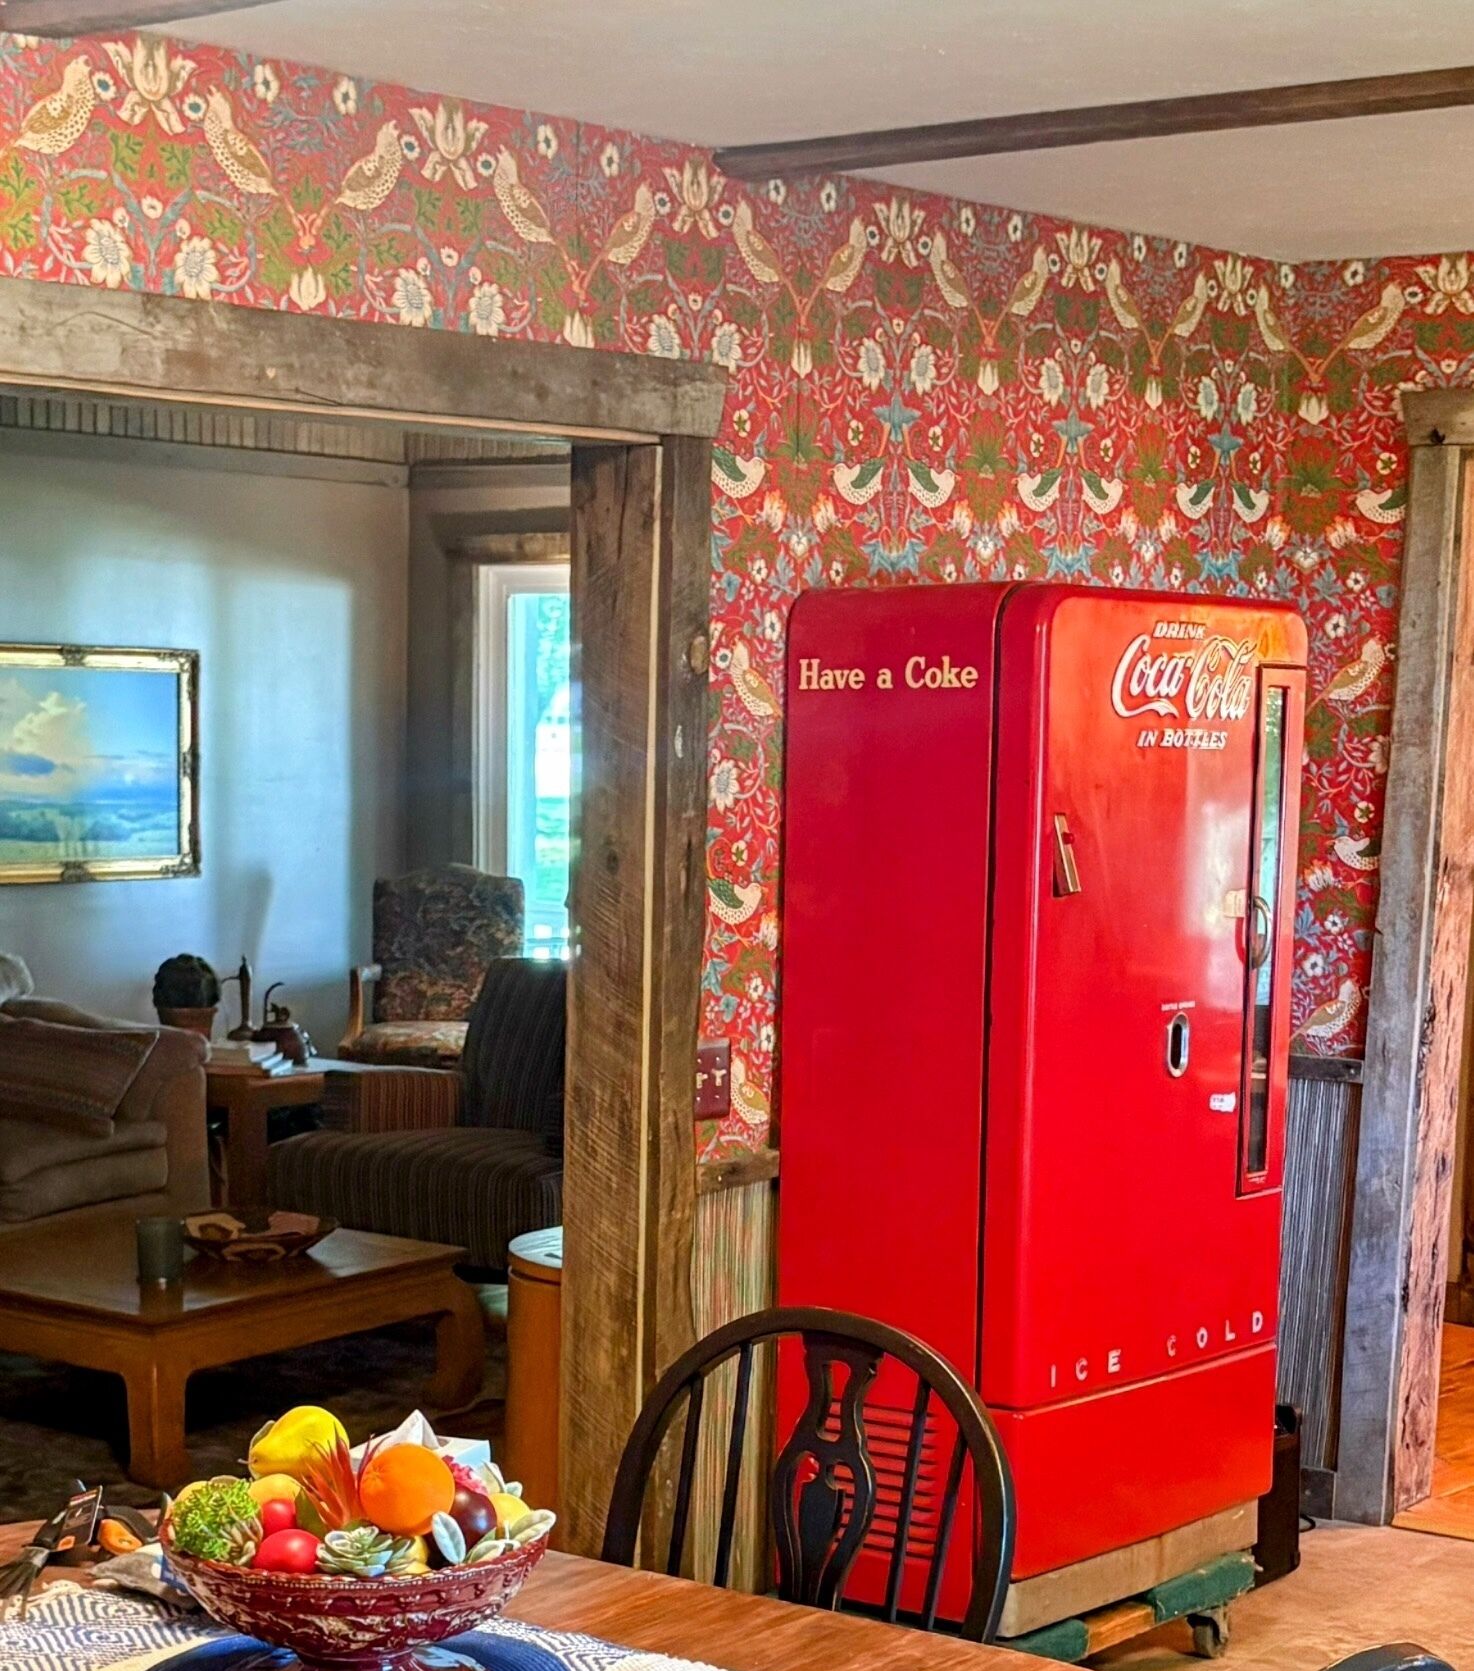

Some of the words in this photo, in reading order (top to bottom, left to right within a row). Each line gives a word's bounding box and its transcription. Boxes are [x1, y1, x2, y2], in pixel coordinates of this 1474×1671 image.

[1152, 621, 1207, 640] DRINK
[799, 658, 865, 690] Have
[876, 668, 894, 690] a
[905, 655, 979, 689] Coke
[1137, 729, 1159, 747] IN
[1160, 727, 1228, 750] BOTTLES
[1051, 1349, 1121, 1388] ICE
[1166, 1311, 1263, 1357] COLD
